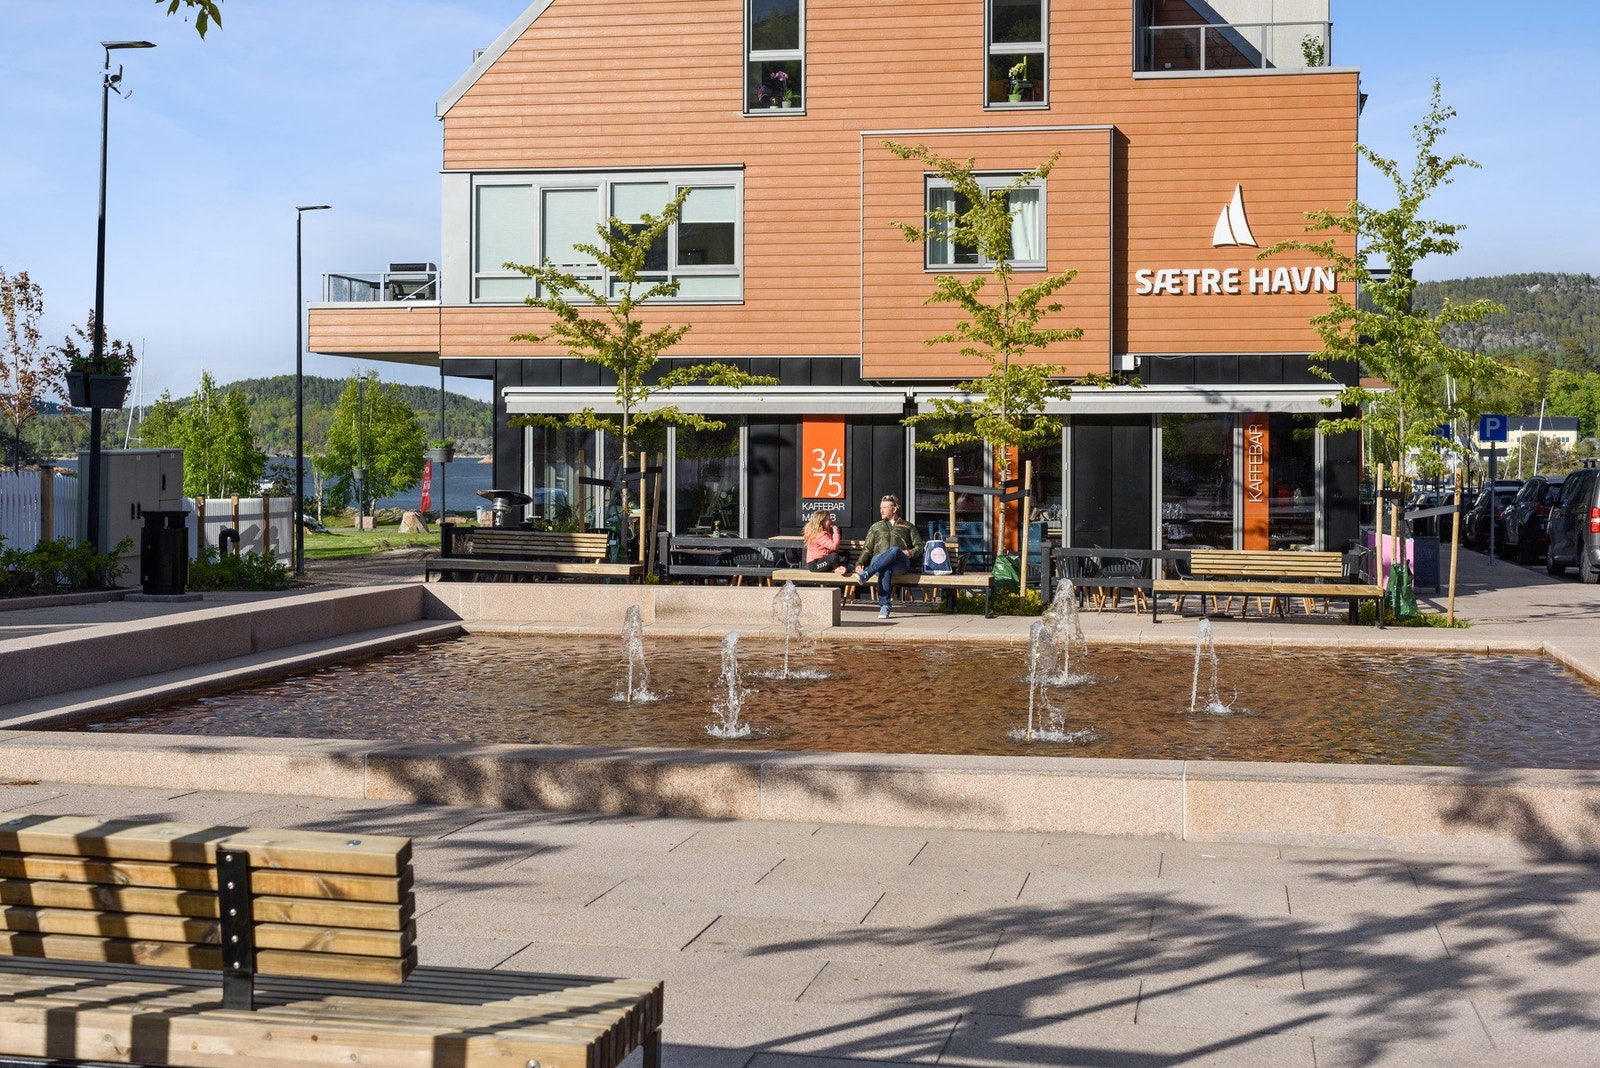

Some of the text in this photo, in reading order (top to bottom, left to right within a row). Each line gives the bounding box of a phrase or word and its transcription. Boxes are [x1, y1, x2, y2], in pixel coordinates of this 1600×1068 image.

[1135, 267, 1335, 294] SÆTRE HAVN
[1486, 417, 1501, 438] P
[811, 448, 844, 473] 34
[1248, 424, 1263, 502] KAFFEBAR
[813, 473, 842, 497] 75
[802, 502, 845, 511] KAFFEBAR
